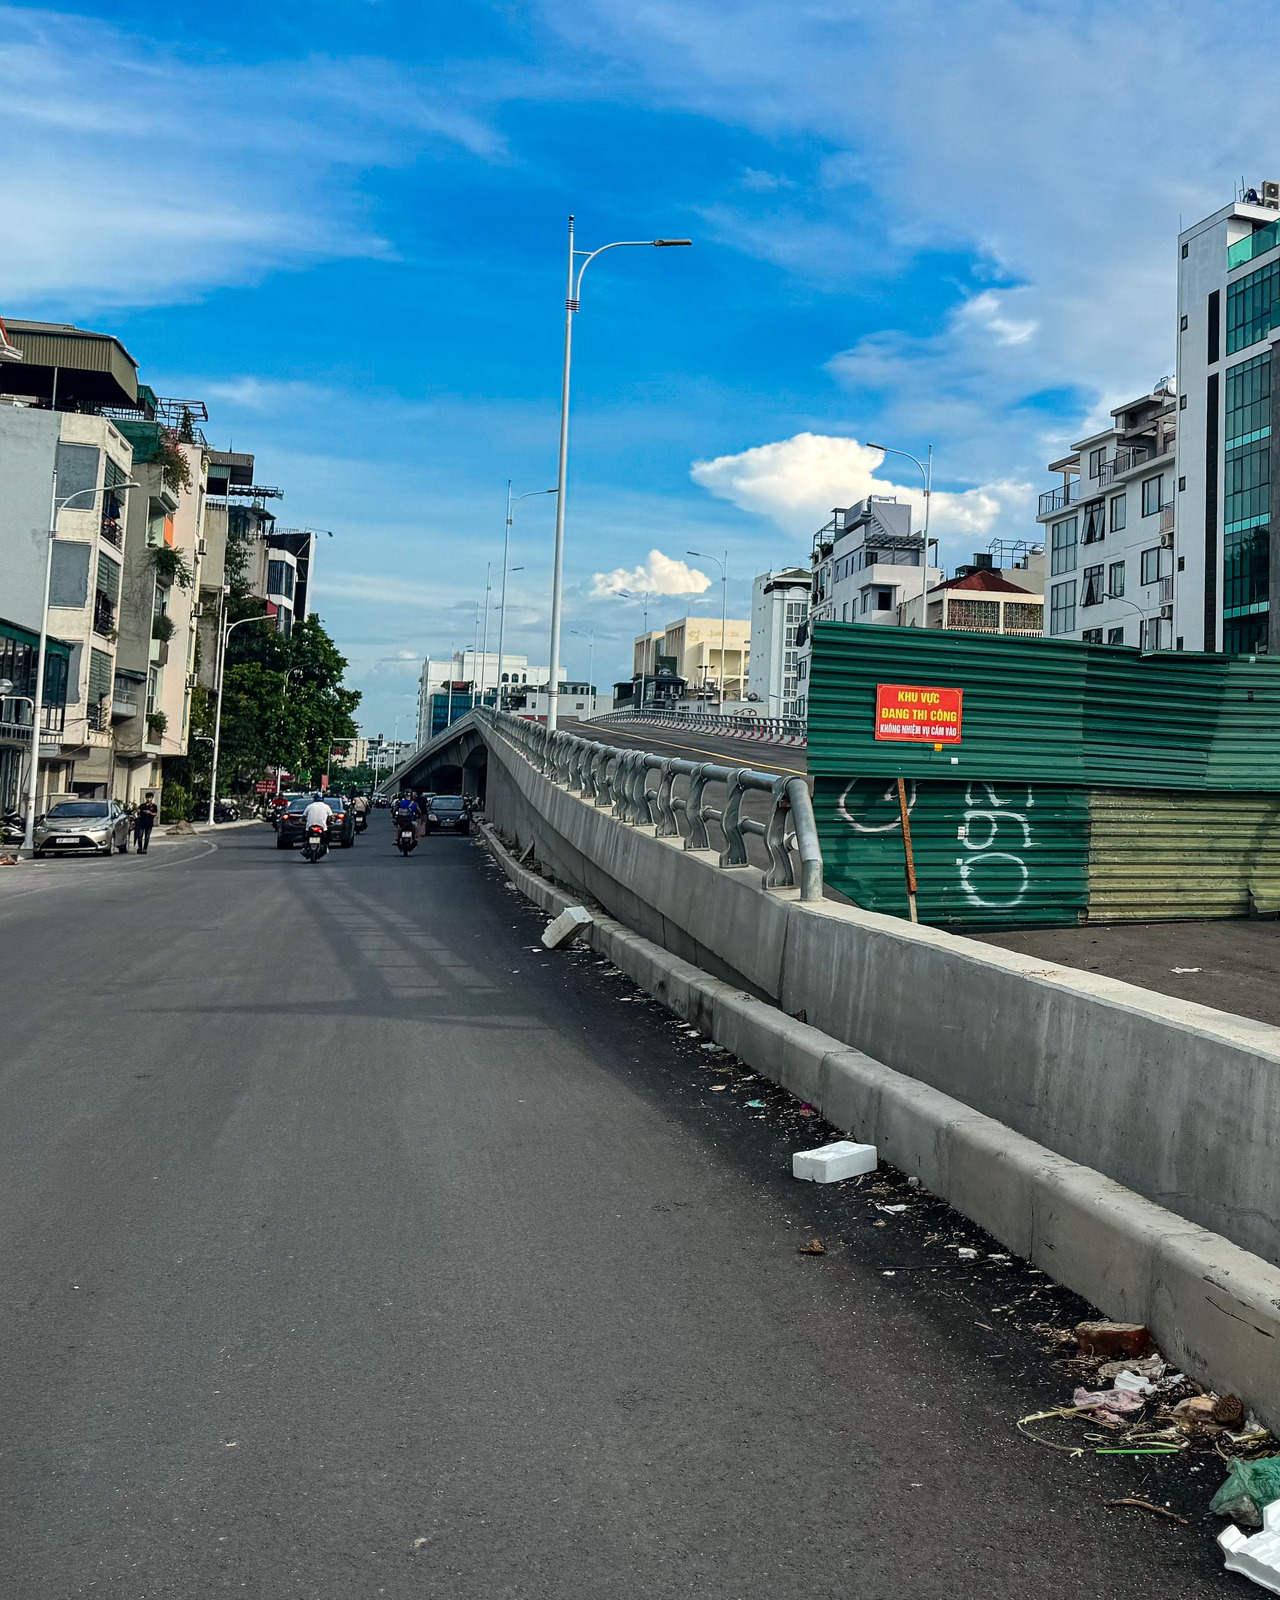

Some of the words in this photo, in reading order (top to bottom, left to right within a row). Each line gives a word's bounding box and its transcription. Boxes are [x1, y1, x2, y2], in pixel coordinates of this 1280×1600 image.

[898, 691, 918, 702] KHU
[920, 692, 940, 706] VỰC
[881, 707, 910, 720] ĐANG
[912, 709, 927, 720] THI
[930, 708, 957, 722] CÔNG
[880, 722, 901, 734] KHÔNG
[901, 723, 921, 737] NHIỆM
[922, 725, 930, 737] VỤ
[931, 723, 945, 736] CẤM
[945, 725, 957, 736] VÀO
